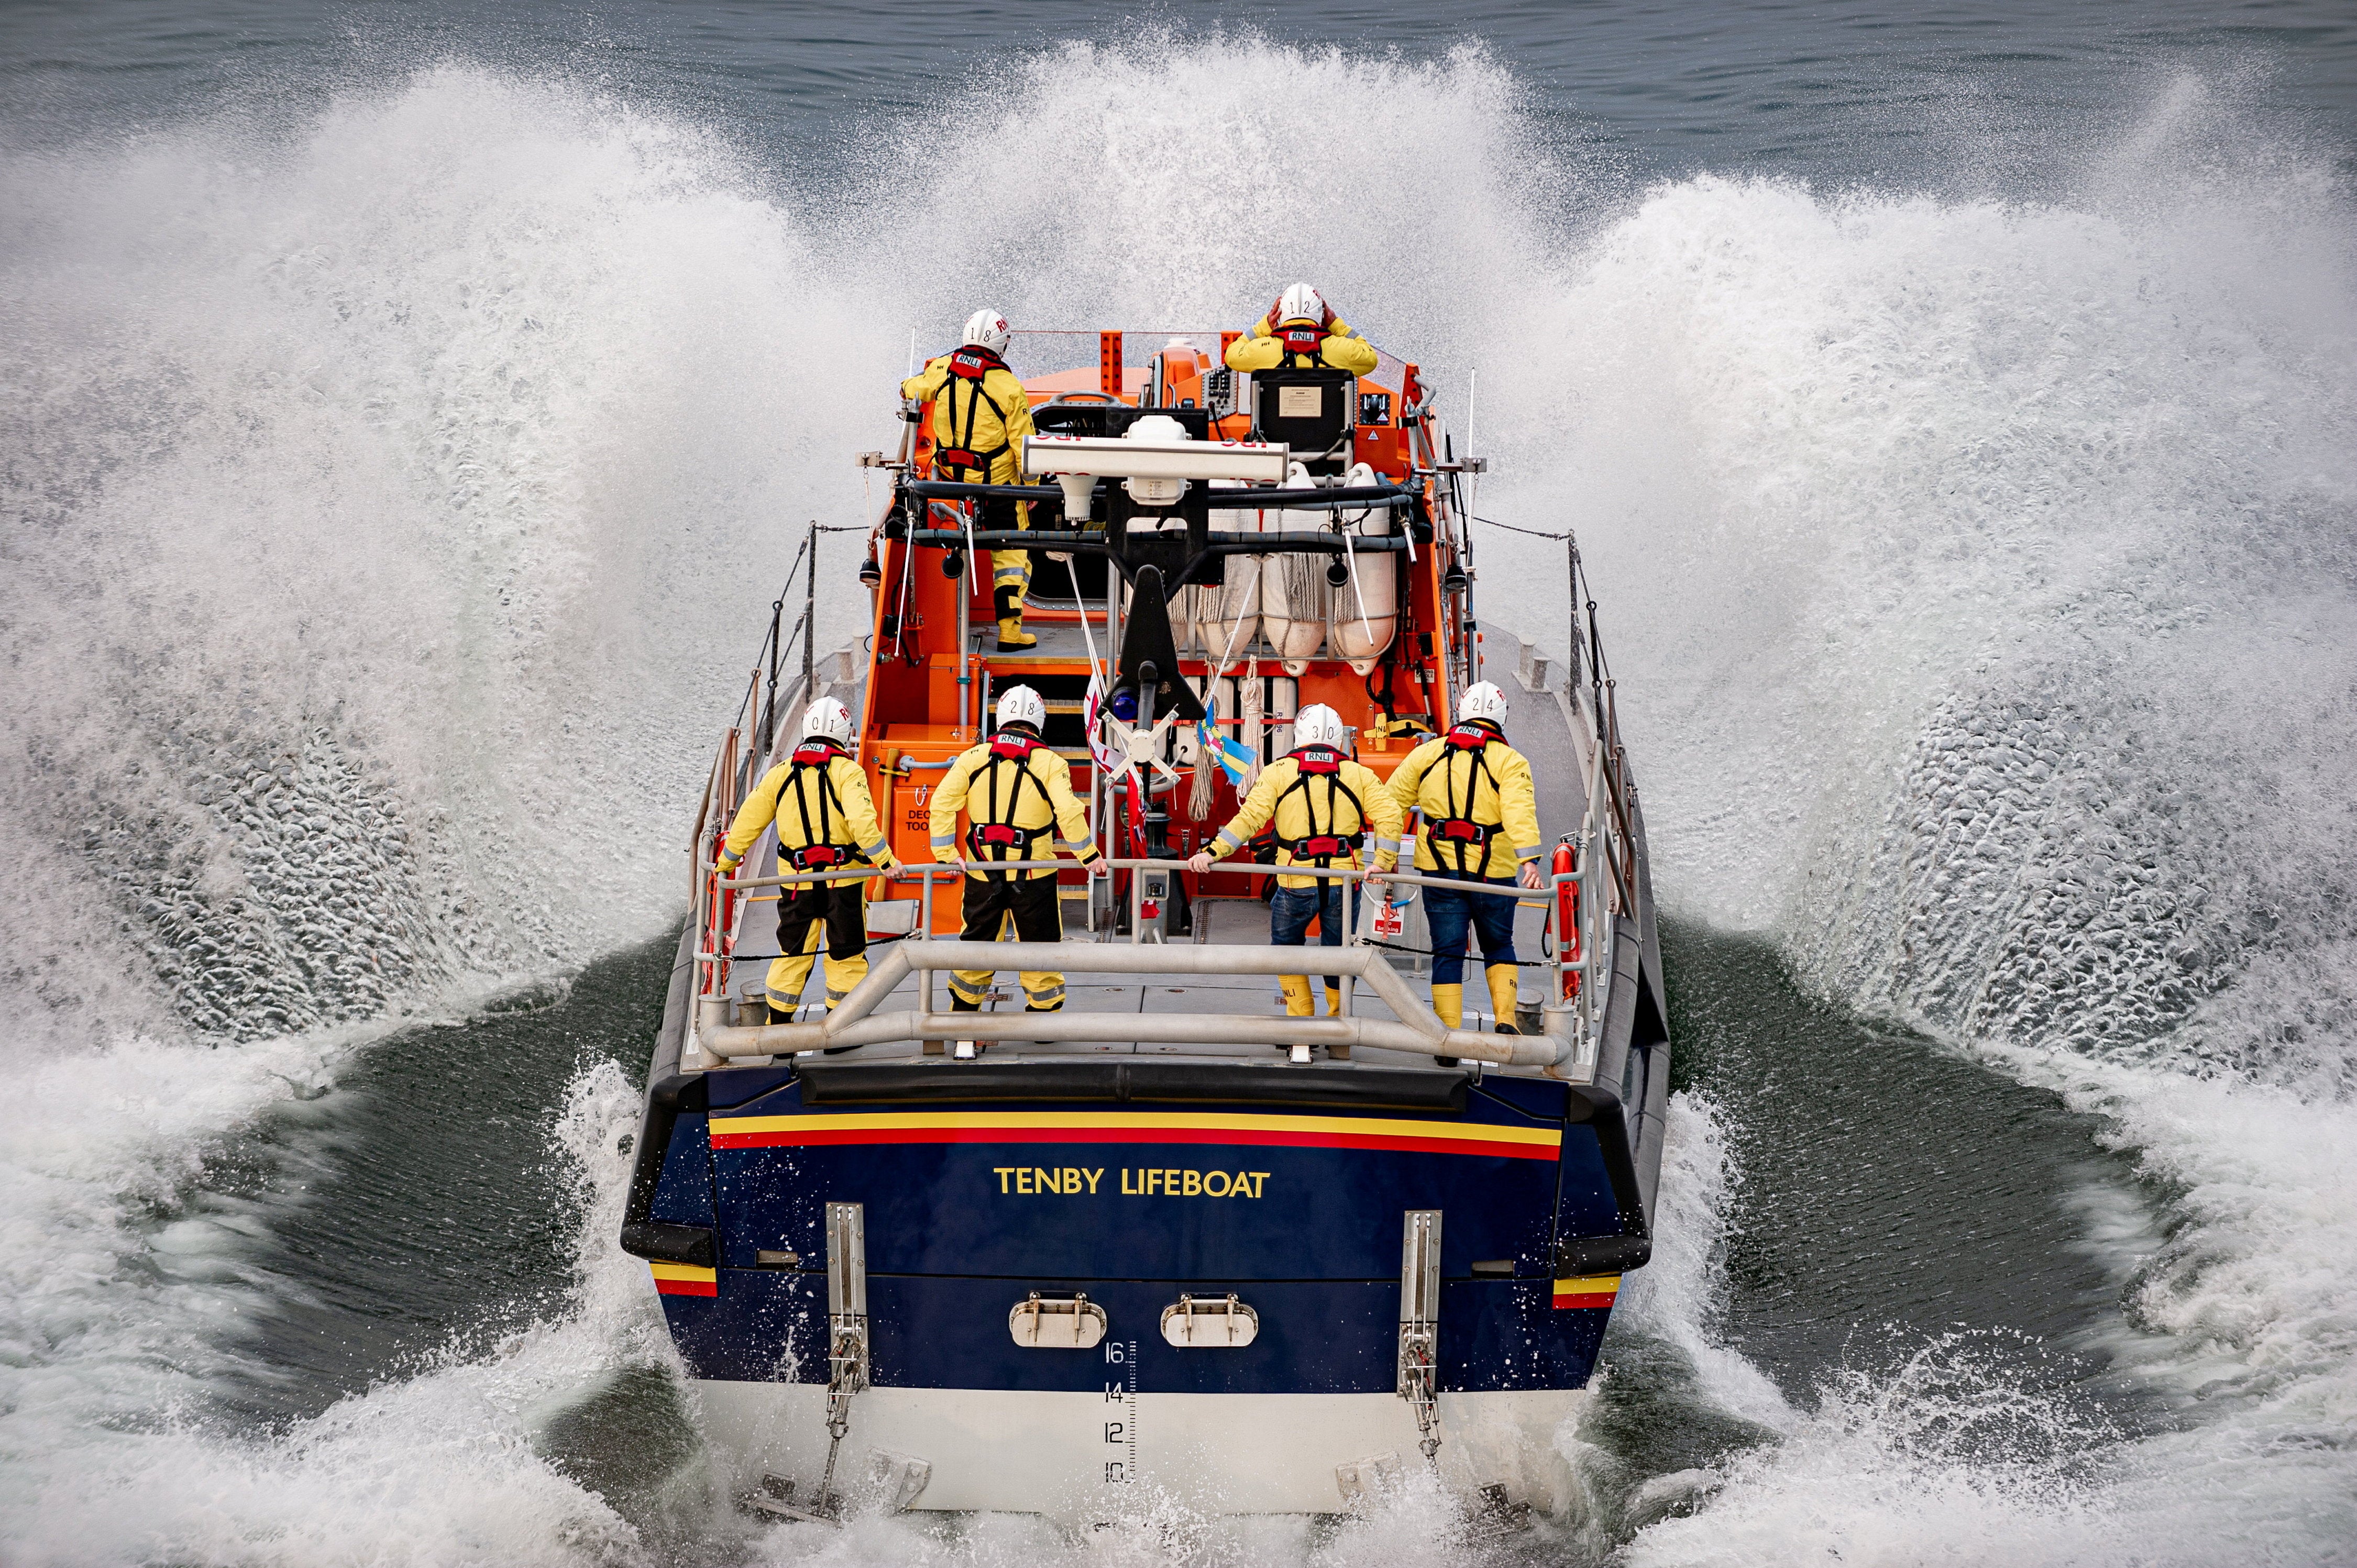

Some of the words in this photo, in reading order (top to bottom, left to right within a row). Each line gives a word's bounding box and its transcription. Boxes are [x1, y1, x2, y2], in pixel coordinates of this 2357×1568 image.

[1292, 332, 1312, 341] RNLI
[959, 355, 978, 367] RNLI
[1459, 726, 1480, 736] RNLI
[1001, 735, 1022, 745] RNLI
[1309, 753, 1330, 761] RNLI
[909, 810, 931, 819] DEC
[906, 822, 929, 831] TOO
[994, 1168, 1104, 1194] TENBY
[1122, 1168, 1271, 1198] LIFEBOAT
[1106, 1342, 1124, 1363] 16
[1106, 1382, 1123, 1403] 14
[1105, 1422, 1123, 1443] 12
[1106, 1462, 1123, 1483] 10
